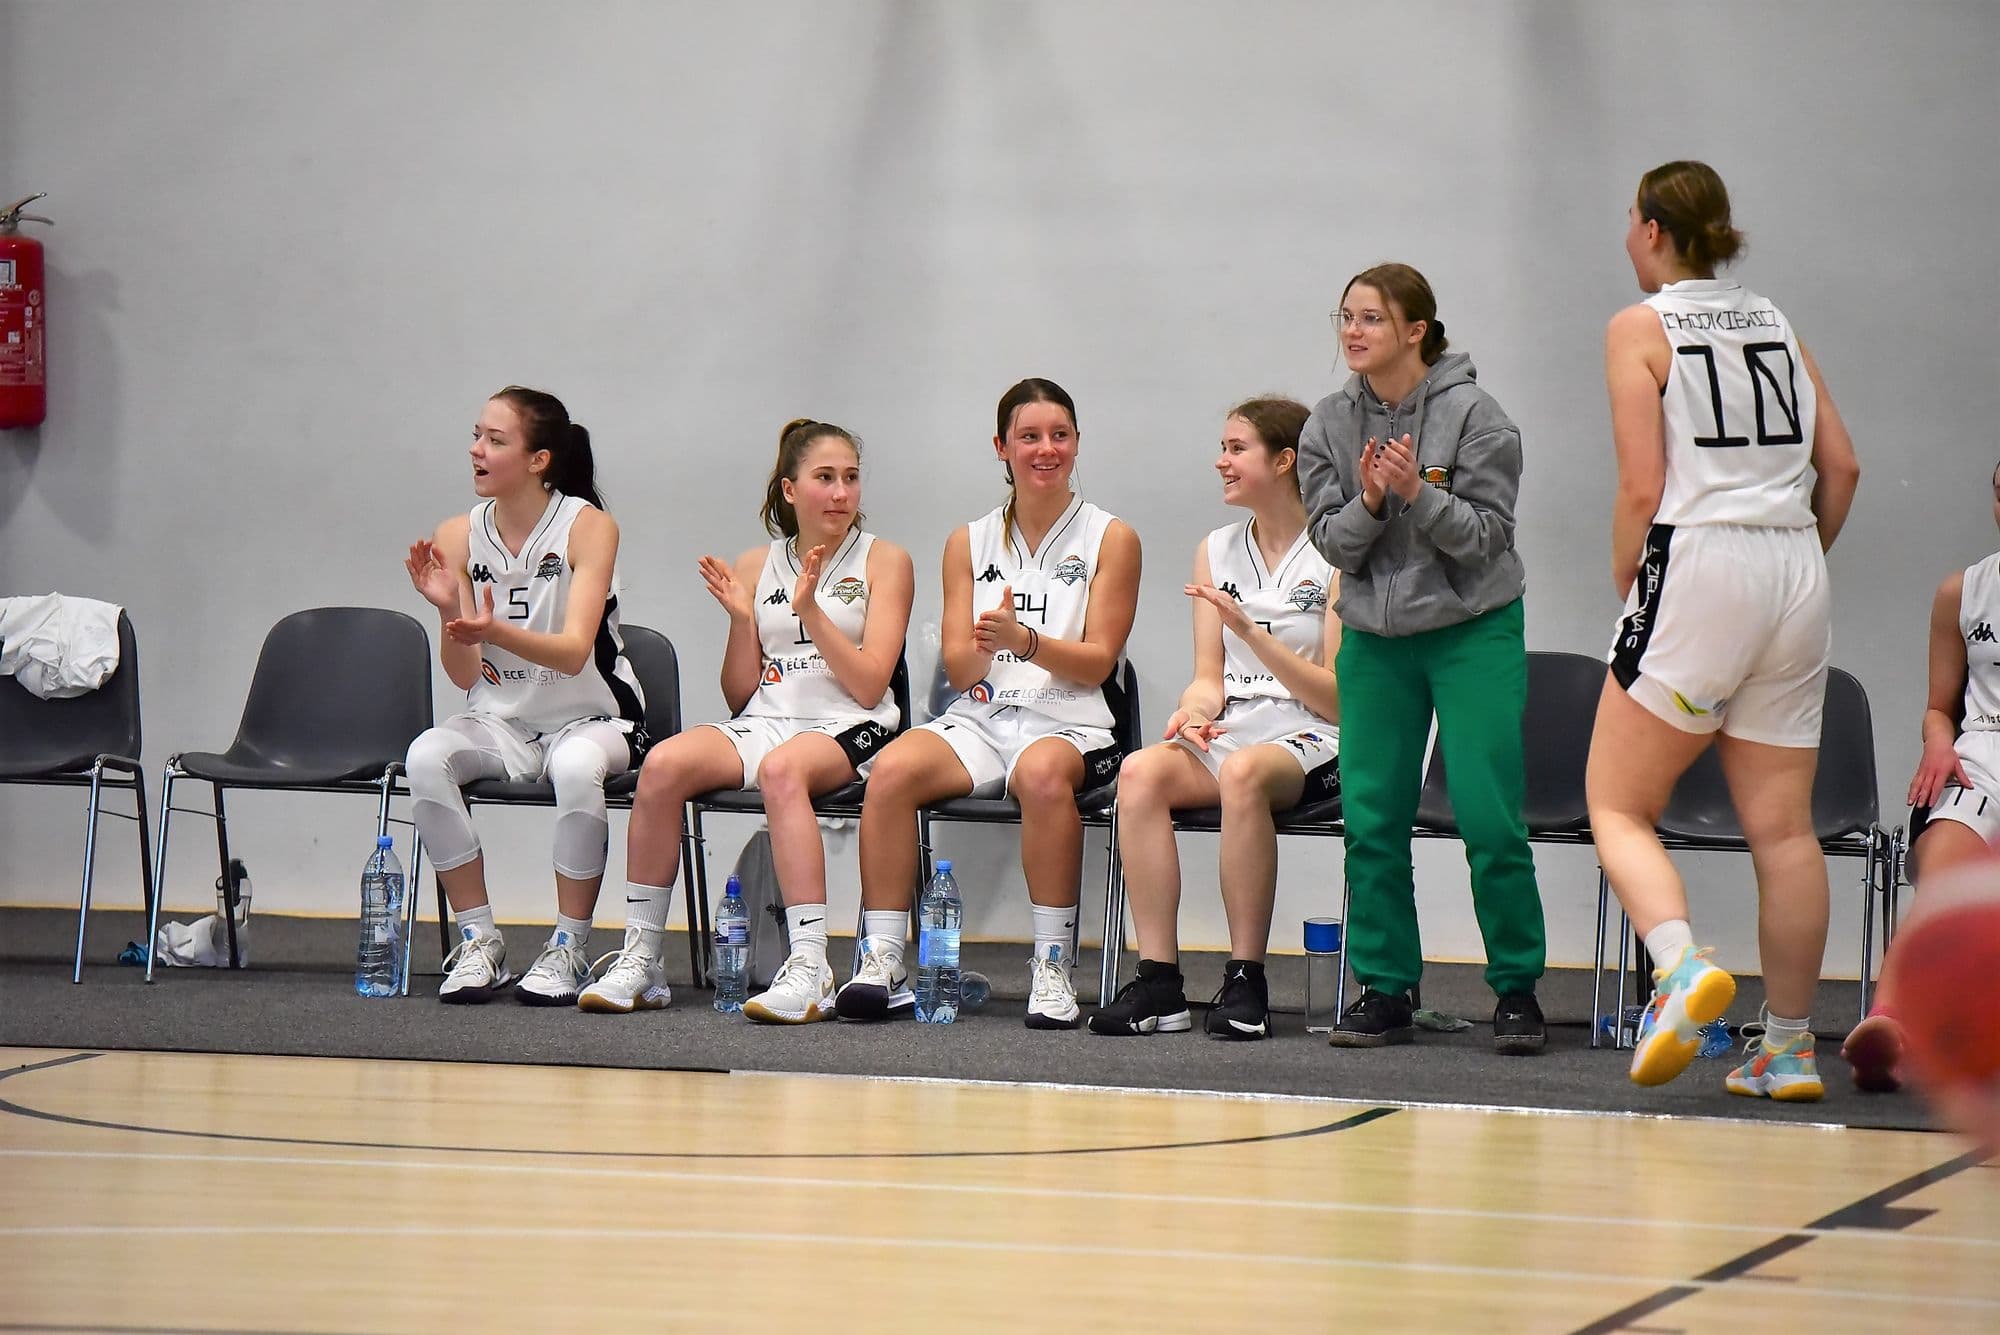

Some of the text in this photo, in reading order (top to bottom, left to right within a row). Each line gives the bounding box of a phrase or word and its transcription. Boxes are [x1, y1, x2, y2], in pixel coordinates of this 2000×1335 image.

[1677, 342, 1803, 447] 10
[508, 587, 529, 619] 5
[503, 670, 527, 680] ECE
[998, 687, 1076, 701] ECE LOGISTICS
